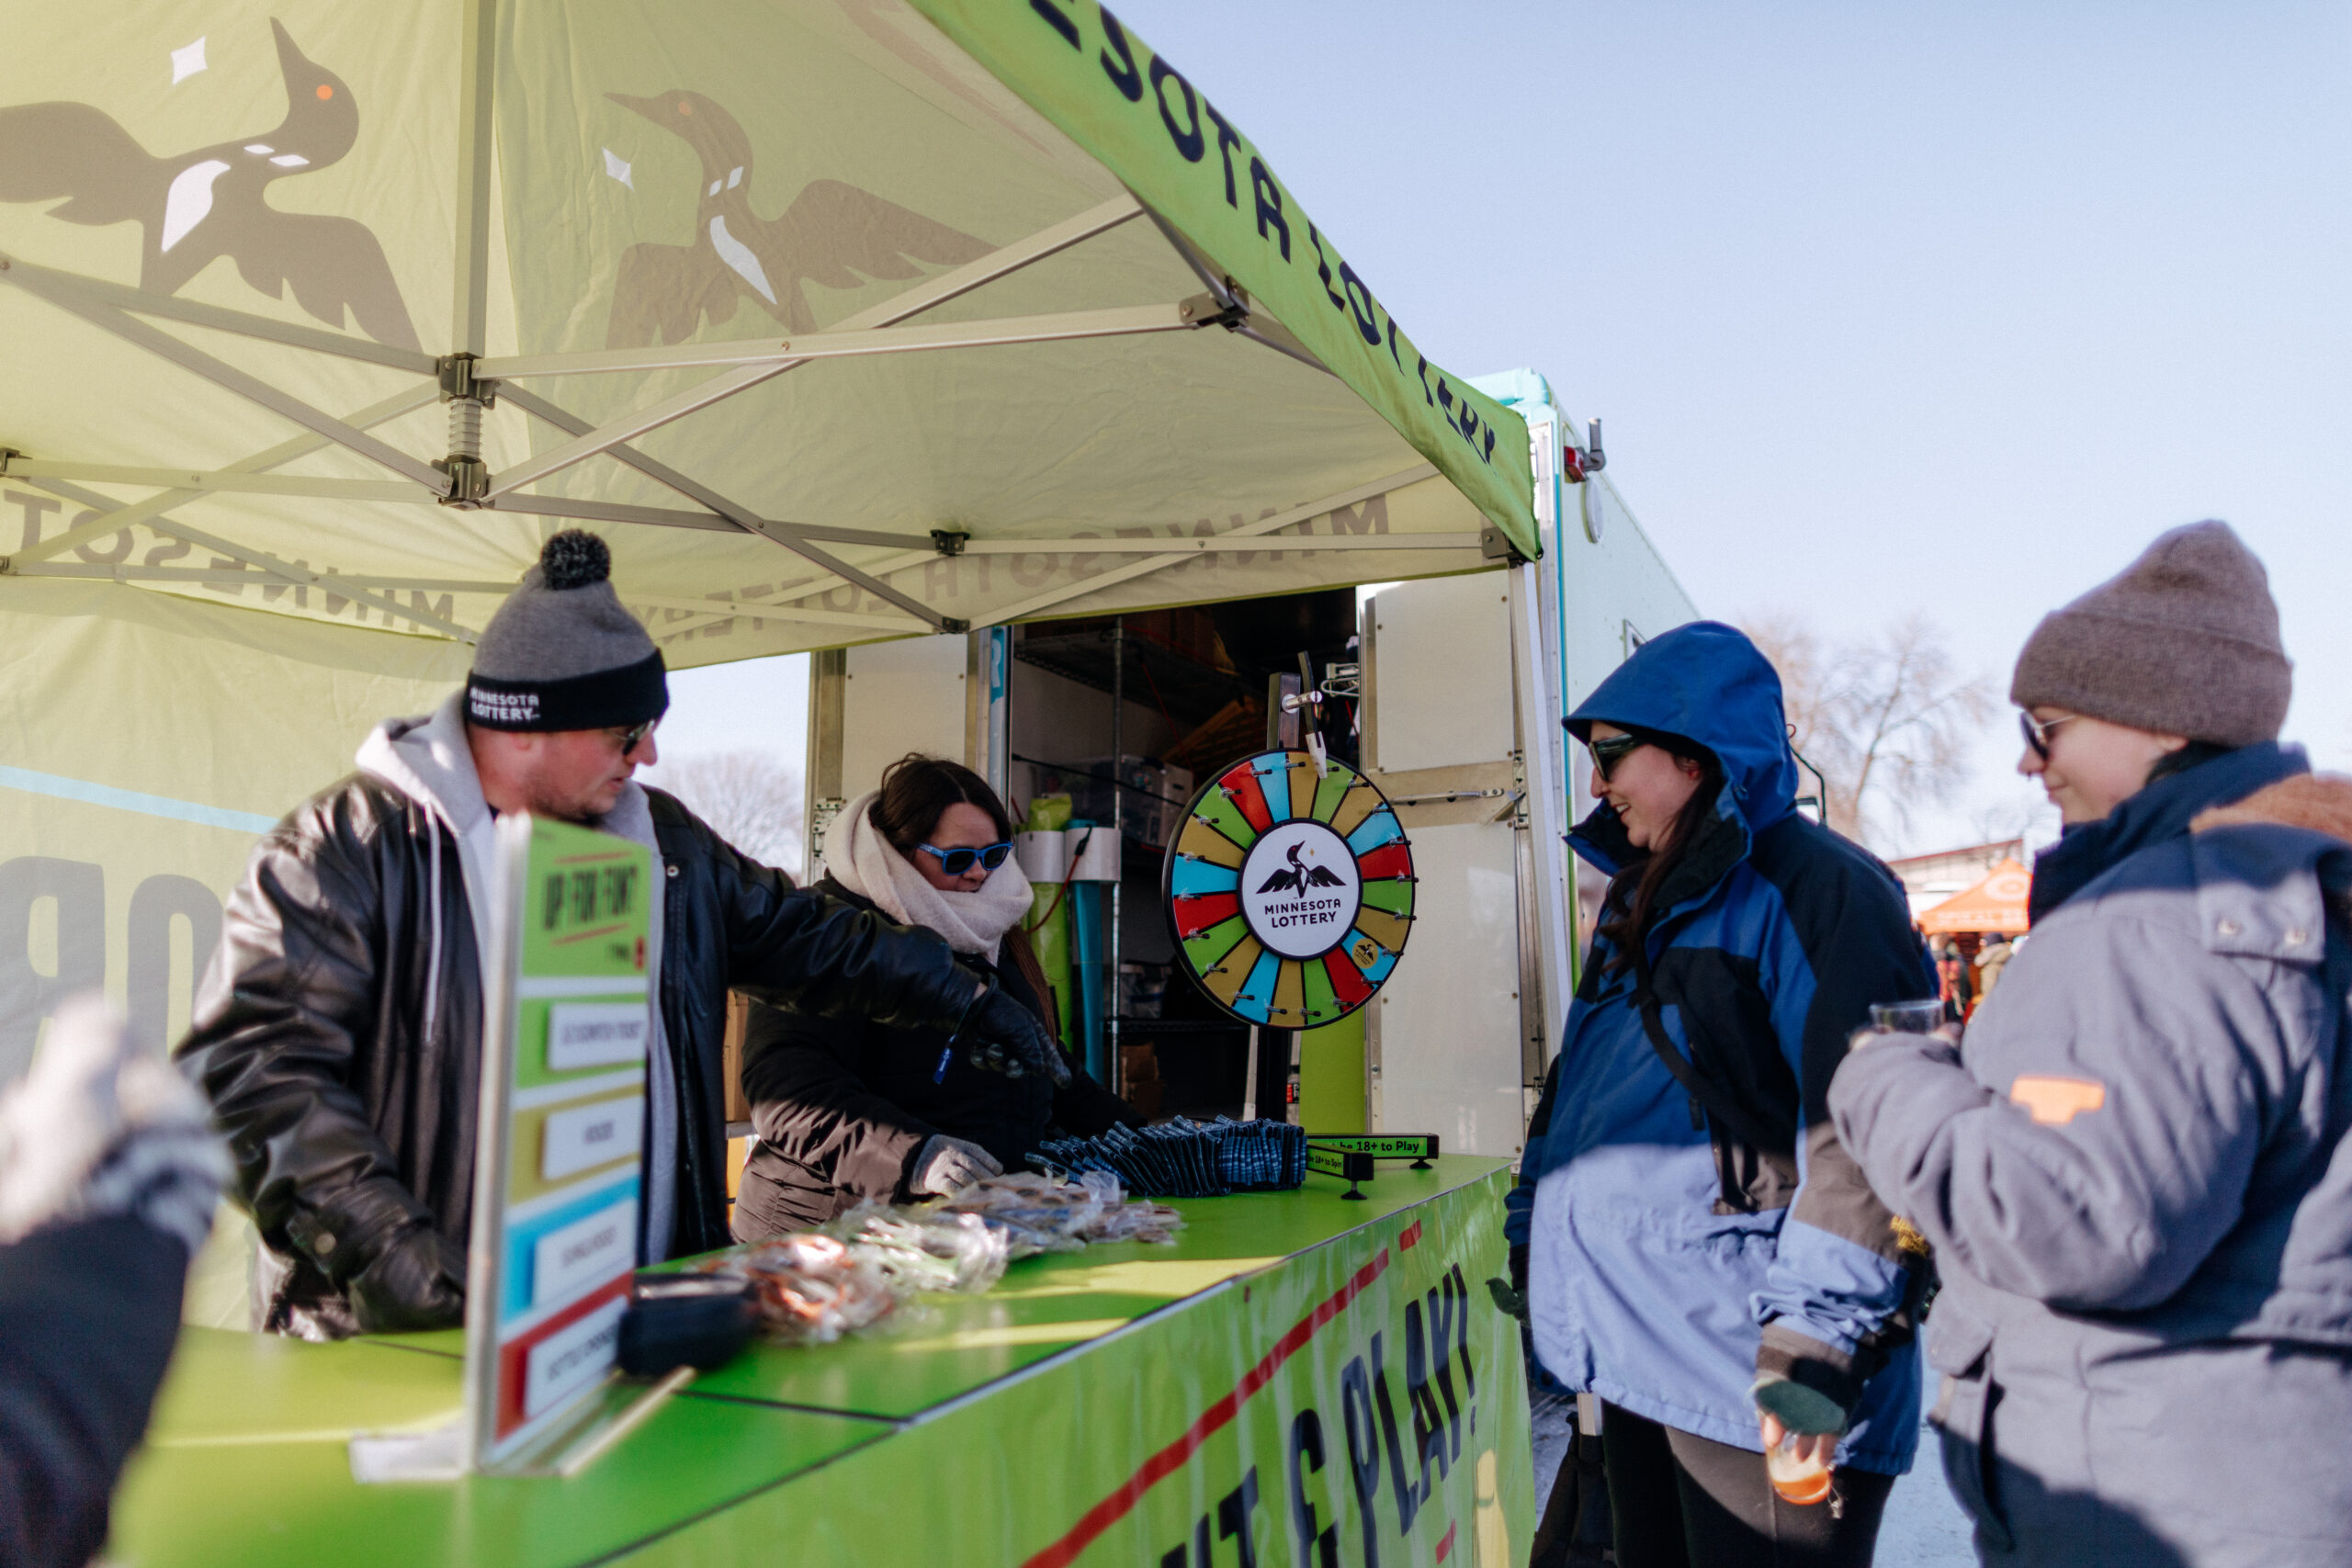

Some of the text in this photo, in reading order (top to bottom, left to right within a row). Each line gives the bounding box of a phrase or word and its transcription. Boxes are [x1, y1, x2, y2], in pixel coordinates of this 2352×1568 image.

[1028, 0, 1291, 265] SOTA
[470, 686, 539, 706] MINNESOTA
[471, 701, 533, 720] LOTTERY
[1264, 898, 1341, 915] MINNESOTA
[1272, 911, 1337, 928] LOTTERY
[1357, 1141, 1377, 1152] 18+
[1381, 1142, 1393, 1151] to
[1396, 1140, 1419, 1154] Play
[1331, 1157, 1342, 1168] Spin
[1341, 1261, 1476, 1568] PLAY!
